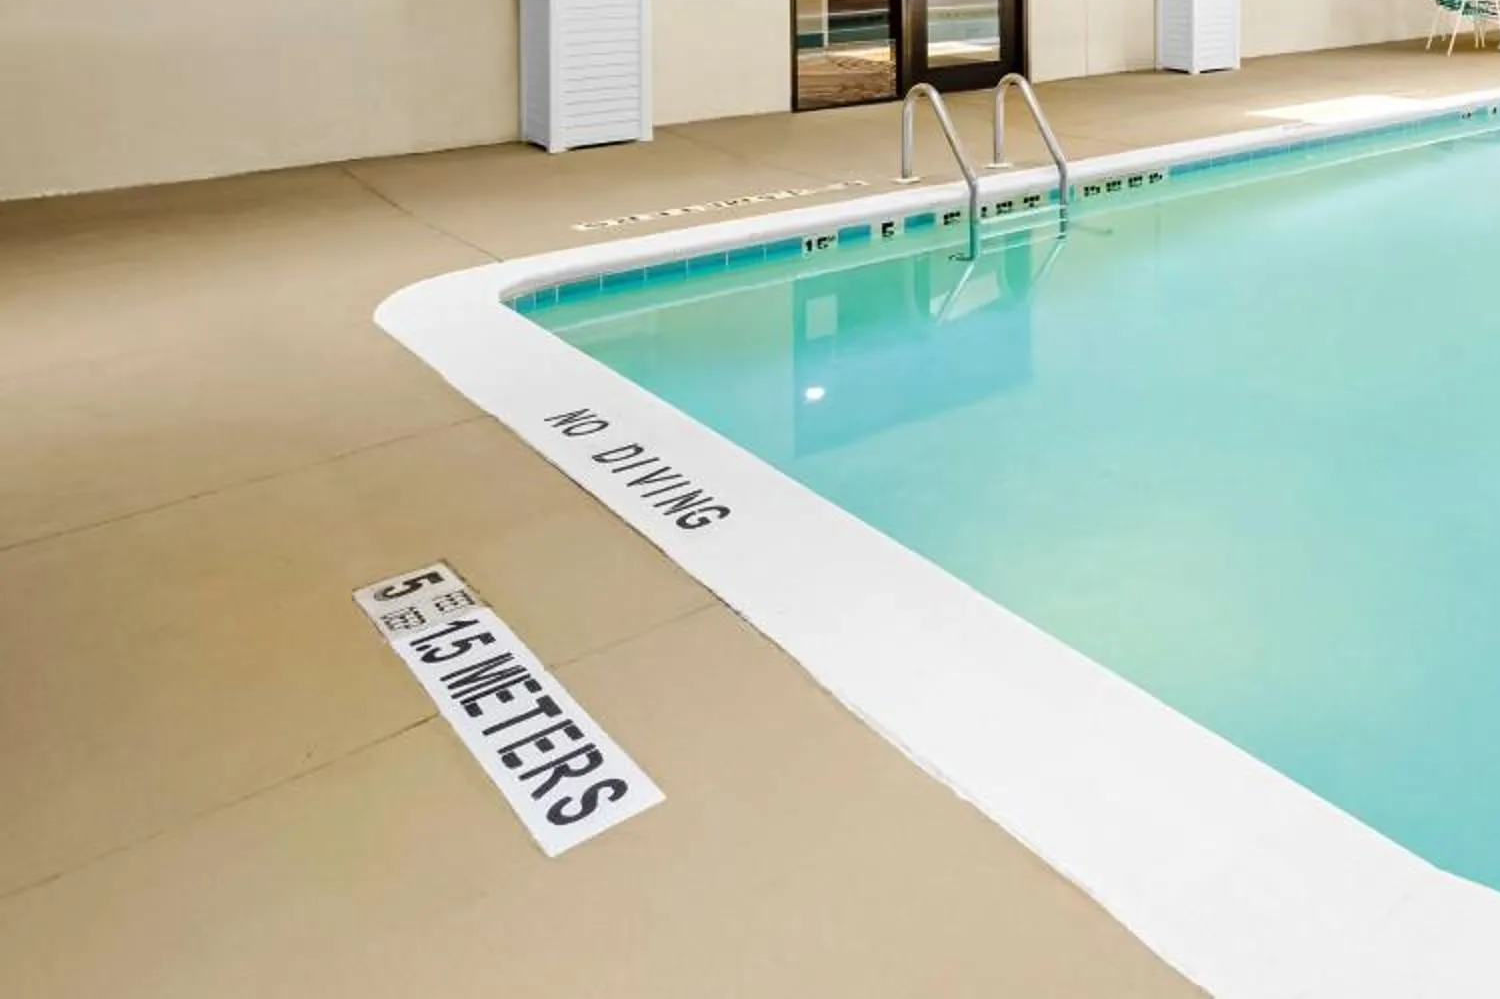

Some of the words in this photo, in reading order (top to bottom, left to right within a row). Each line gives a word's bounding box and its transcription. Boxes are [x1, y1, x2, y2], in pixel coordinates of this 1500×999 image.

[544, 407, 609, 437] NO
[591, 442, 731, 530] DIVING
[373, 571, 445, 602] 5
[439, 652, 630, 827] METERS
